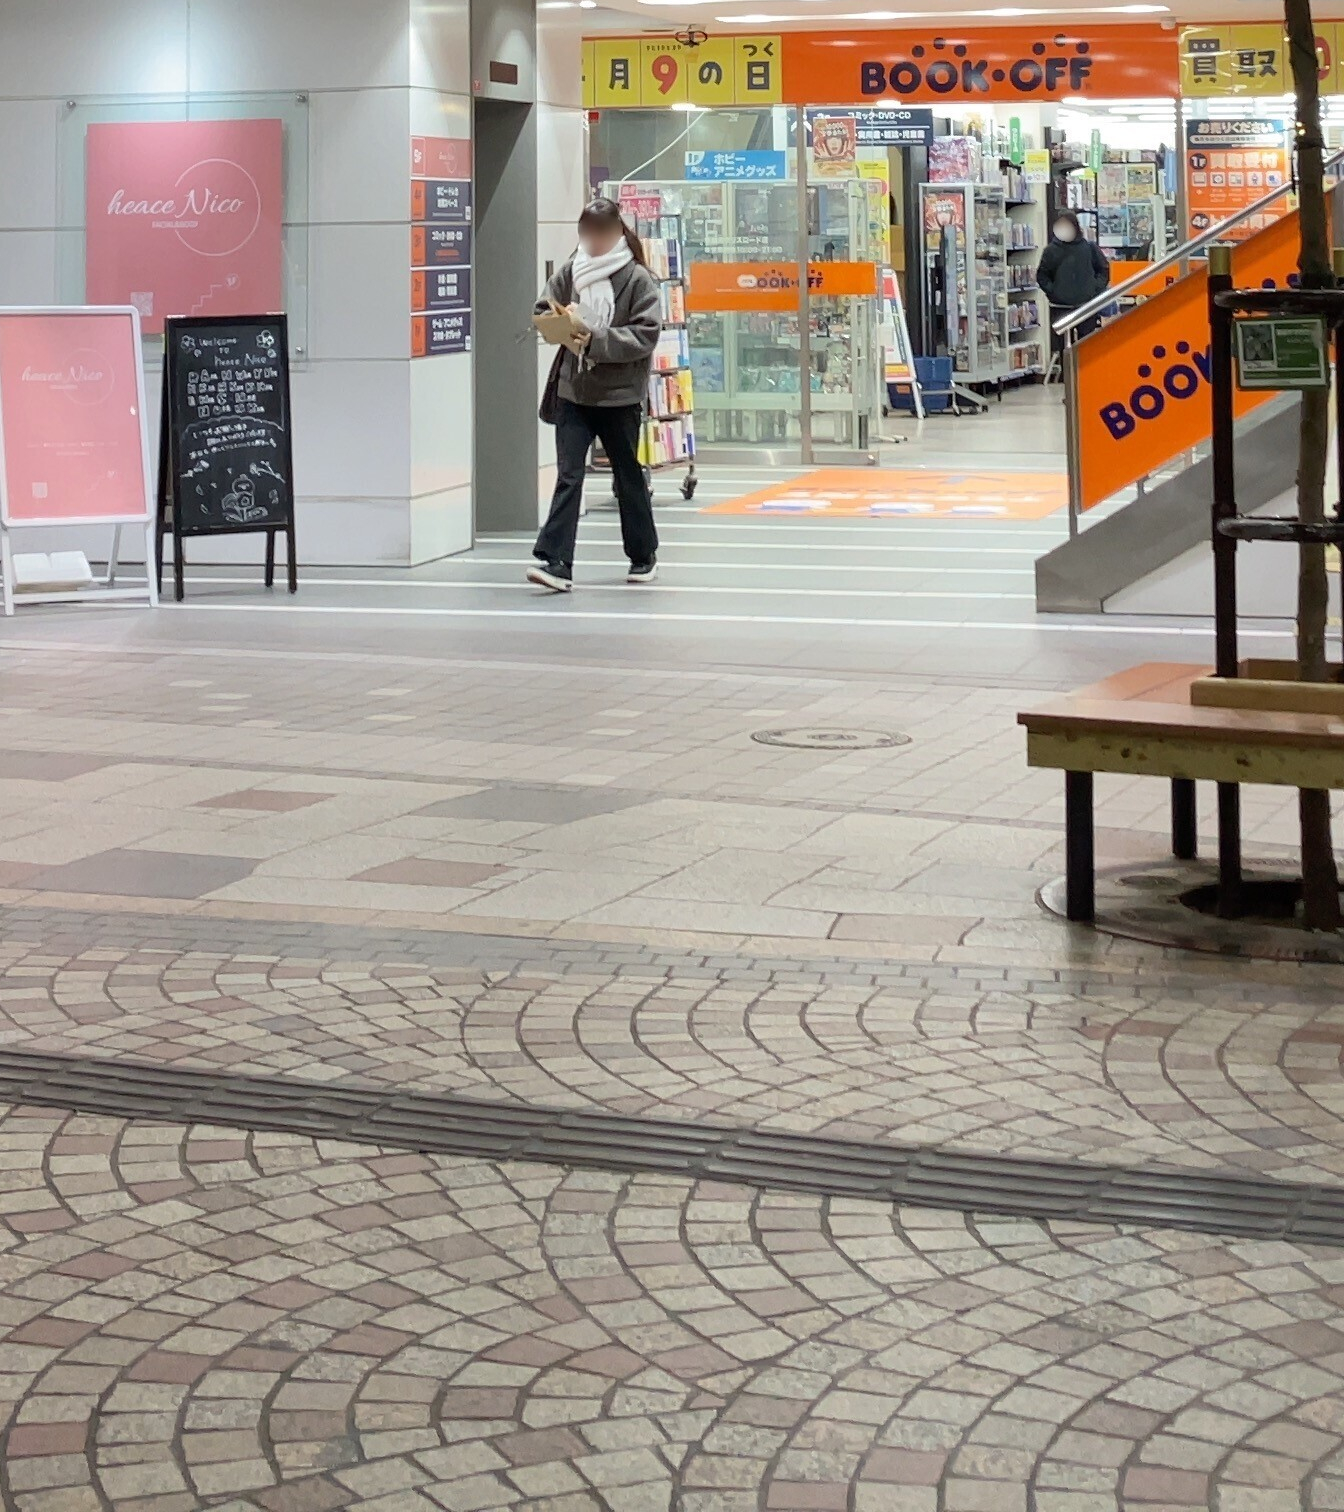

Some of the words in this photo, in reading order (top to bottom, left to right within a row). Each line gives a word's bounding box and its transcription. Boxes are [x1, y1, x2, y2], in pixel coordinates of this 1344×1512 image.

[713, 153, 747, 165] ホビー
[713, 165, 777, 178] アニメグッズ
[107, 189, 176, 215] heace
[175, 187, 245, 219] Nico
